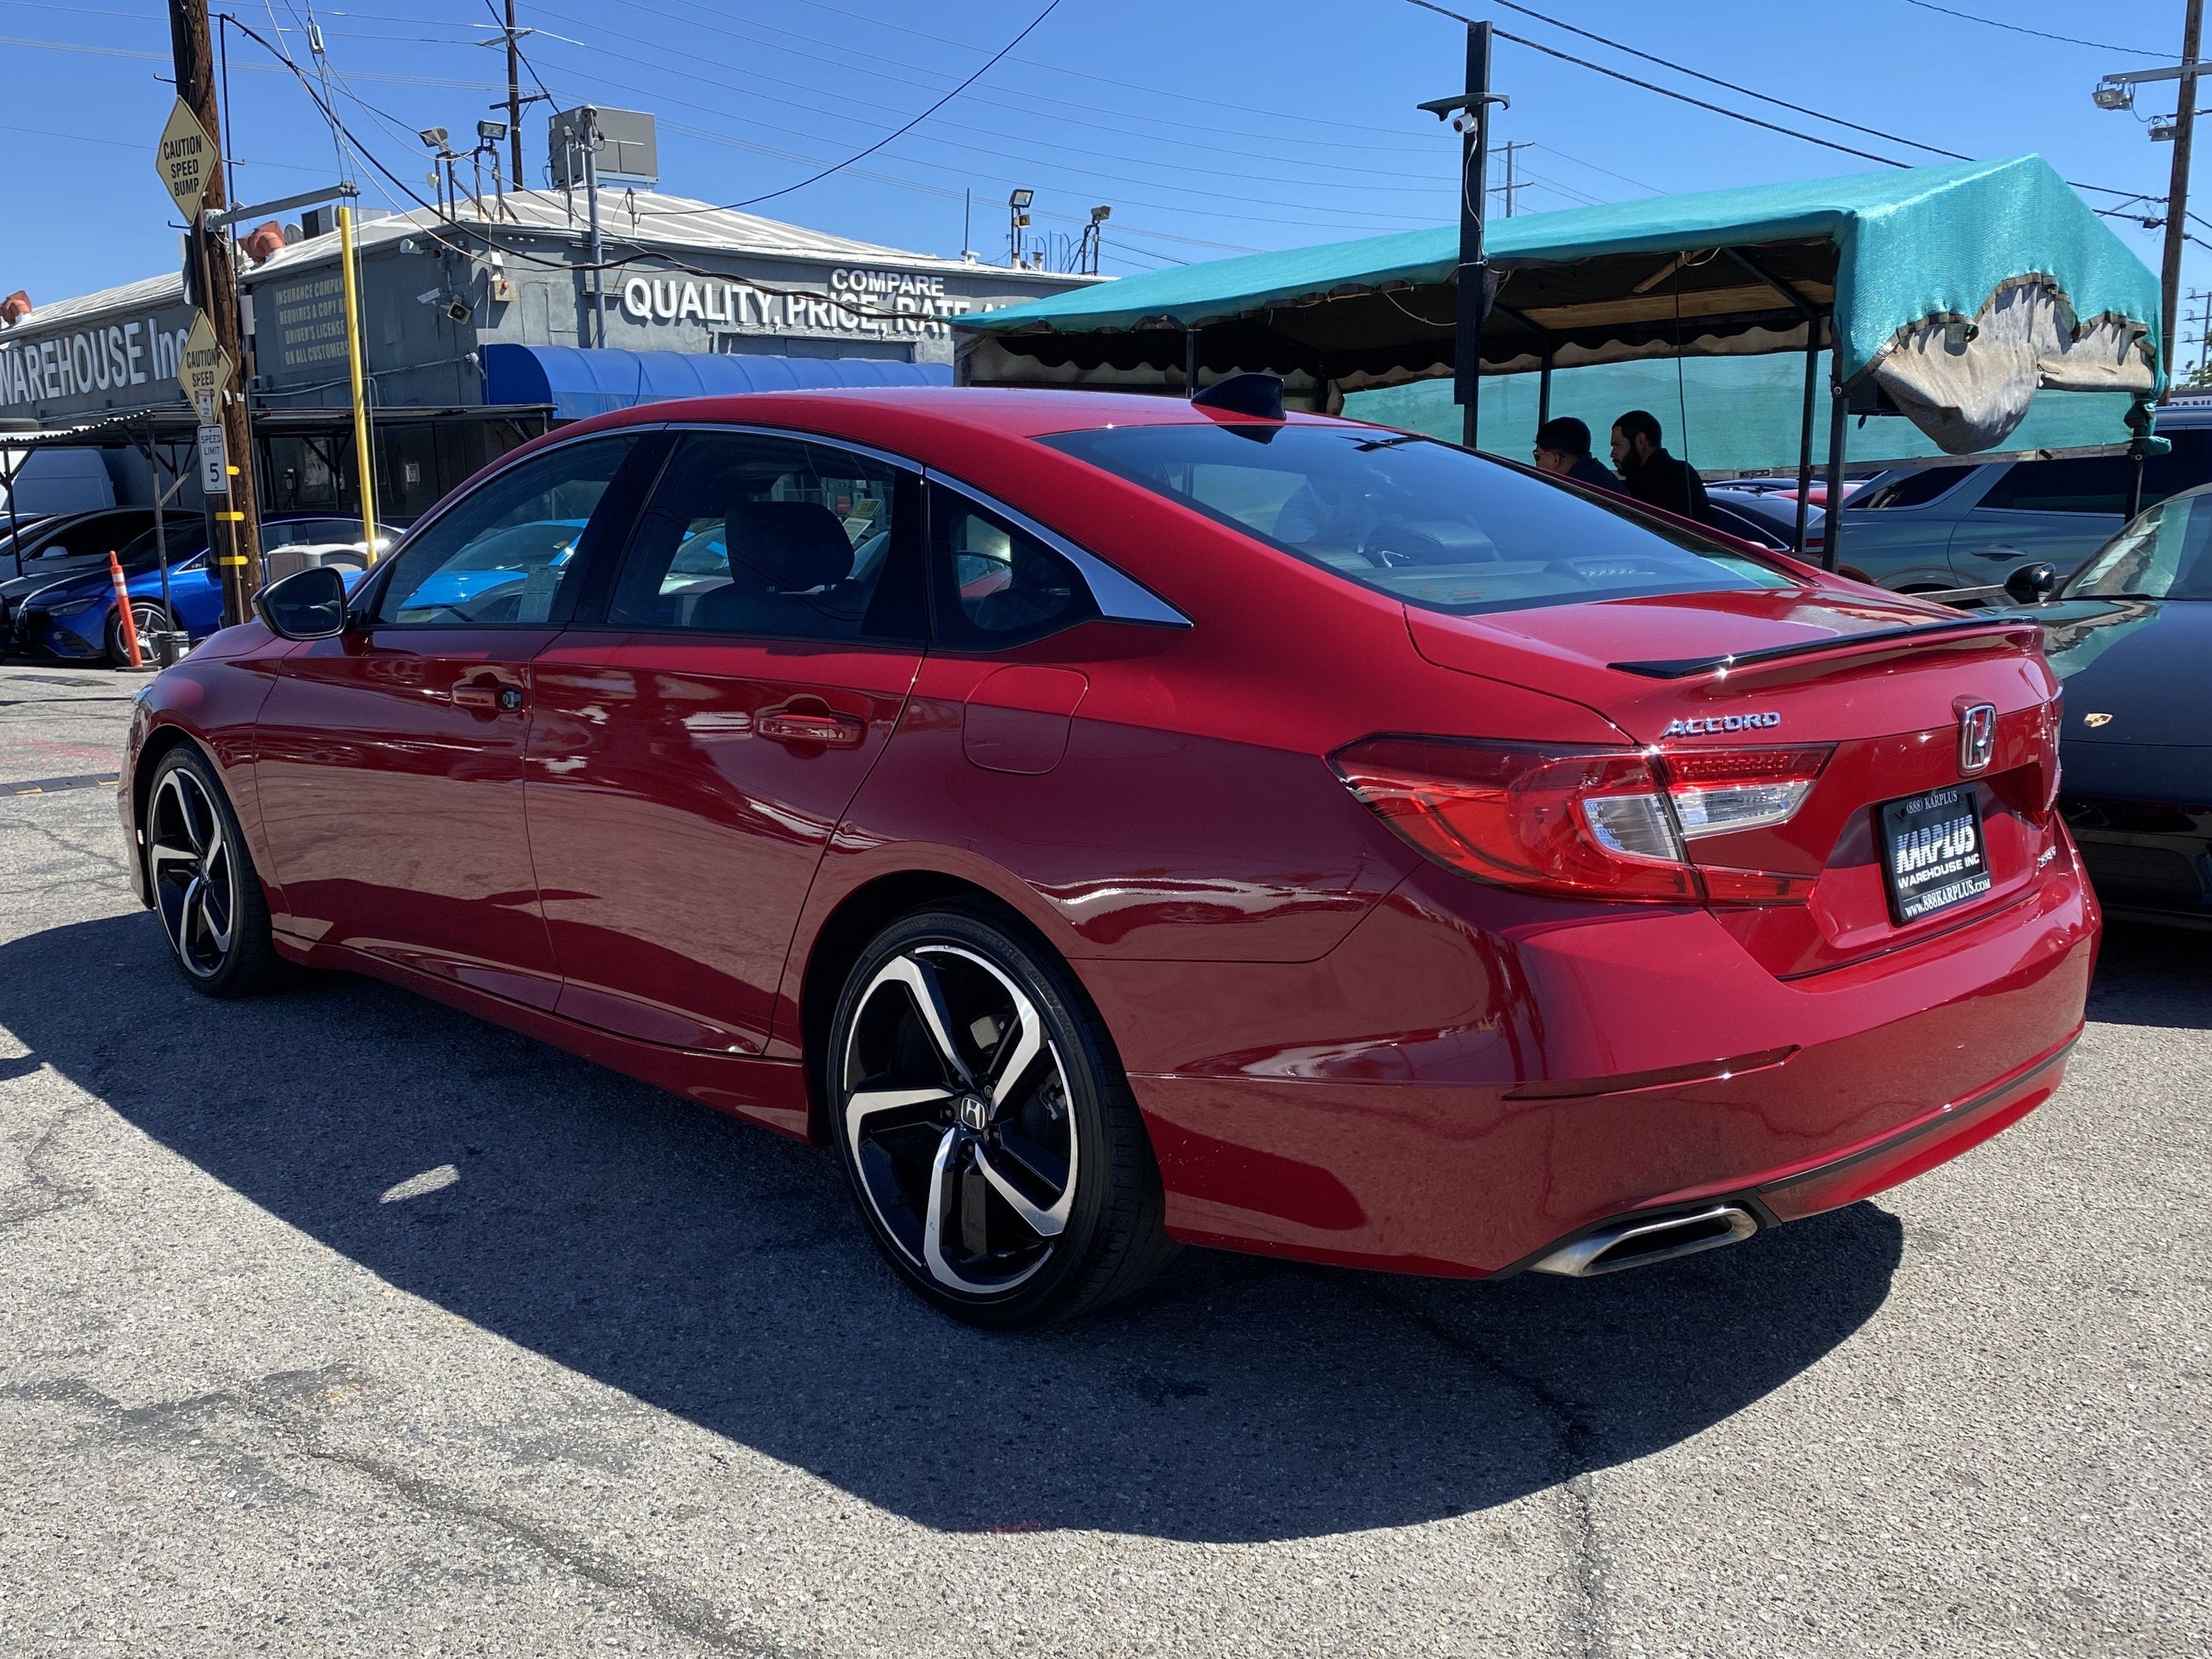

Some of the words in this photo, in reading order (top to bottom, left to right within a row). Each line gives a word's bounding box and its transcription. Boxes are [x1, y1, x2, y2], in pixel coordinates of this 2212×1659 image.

[163, 134, 202, 161] CAUTION
[170, 159, 199, 179] SPEED
[174, 178, 199, 197] BUMP
[275, 284, 313, 306] INSURANCE
[314, 277, 344, 297] COMPAN
[831, 268, 944, 297] COMPARE
[279, 305, 311, 325] REQUIRES
[312, 304, 317, 319] A
[318, 300, 336, 318] COPY
[624, 277, 781, 331] QUALITY,
[285, 325, 316, 345] DRIVER'S
[316, 320, 345, 339] LICENSE
[187, 349, 218, 369] CAUTION
[285, 351, 296, 365] ON
[296, 348, 308, 363] ALL
[307, 340, 350, 361] CUSTOMERS
[192, 371, 214, 387] SPEED
[195, 389, 215, 404] BP
[201, 434, 221, 444] SPEED
[204, 446, 220, 456] LIMIT
[210, 462, 219, 483] 5
[1659, 711, 1781, 740] ACCORD
[1906, 799, 1923, 815] (888)
[1924, 789, 1958, 810] KARPLUS
[1896, 814, 1975, 873] KARPLUS
[1898, 859, 1963, 890] WAREHOUSE
[1964, 853, 1980, 868] INC
